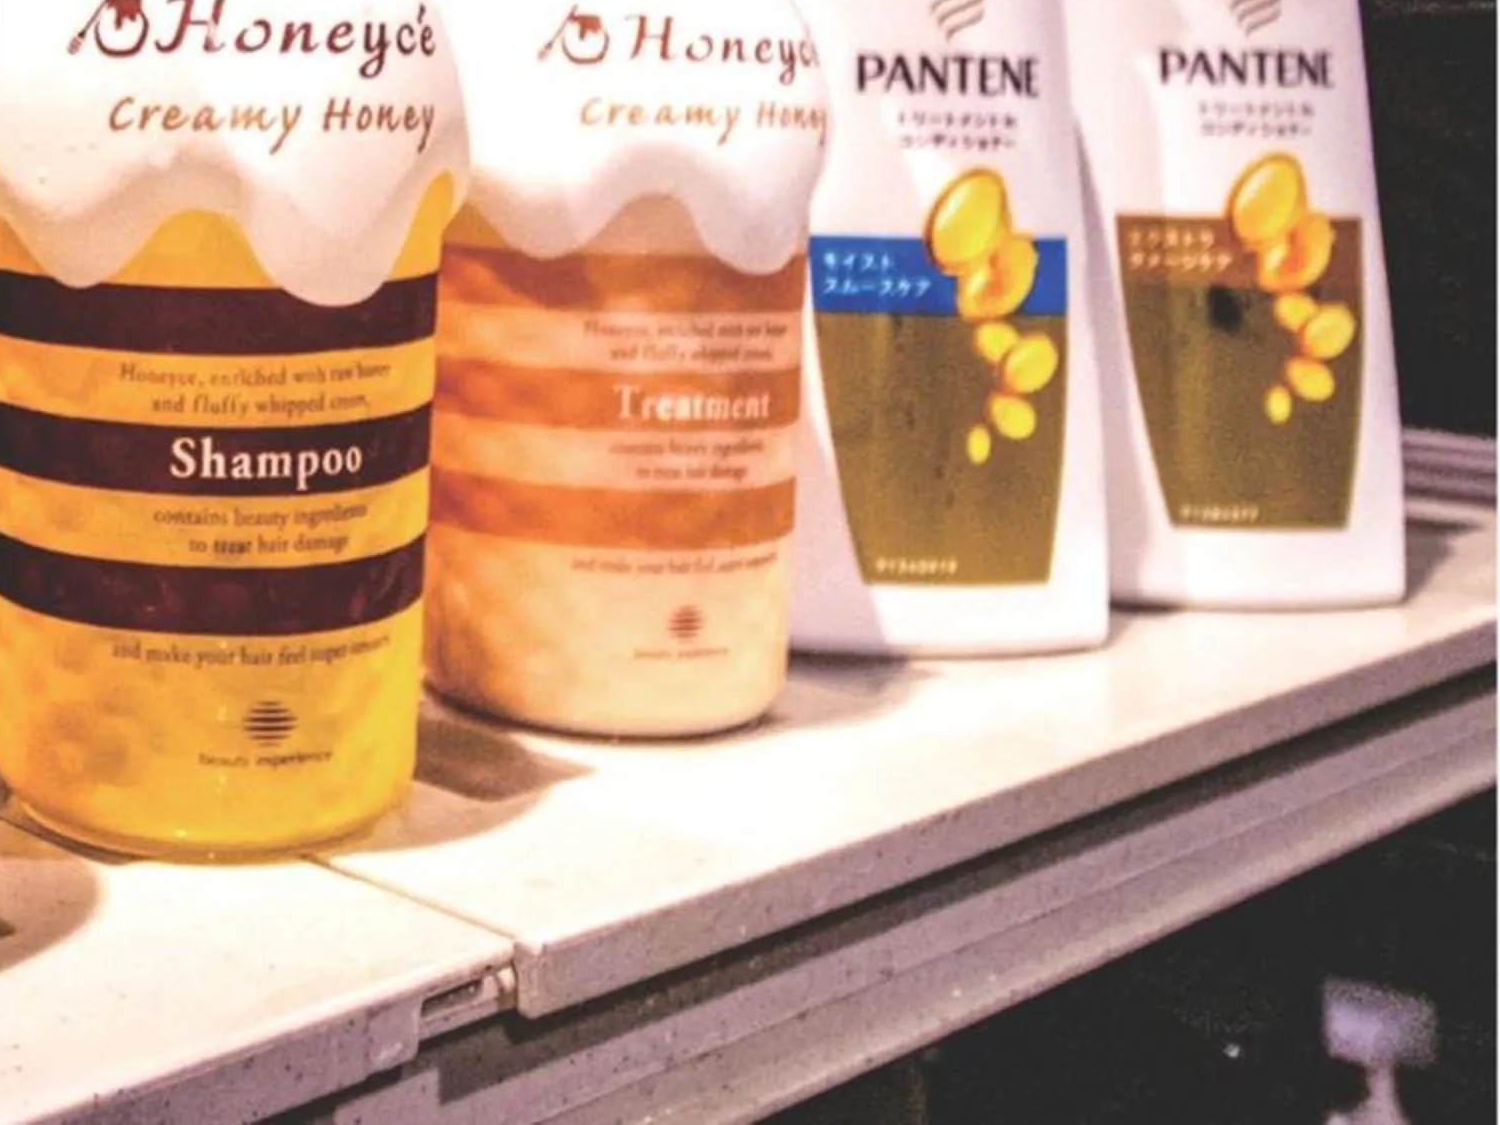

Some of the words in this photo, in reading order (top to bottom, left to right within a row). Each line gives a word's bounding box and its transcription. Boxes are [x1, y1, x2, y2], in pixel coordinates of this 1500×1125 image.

[856, 53, 1041, 98] PANTENE
[1159, 48, 1335, 89] PANTENE
[108, 96, 303, 156] Creamy
[322, 97, 436, 154] Honey
[580, 96, 741, 147] Creamy
[210, 363, 288, 387] enriched
[152, 395, 184, 414] and
[193, 393, 250, 417] fluffy
[255, 392, 328, 417] whipped
[613, 383, 771, 421] Treatment
[169, 436, 363, 491] Shampoo
[153, 506, 230, 526] contains
[189, 538, 207, 554] to
[257, 535, 290, 554] hair
[111, 641, 142, 660] and
[145, 643, 192, 664] make
[196, 649, 237, 669] your
[240, 647, 273, 666] hair
[278, 644, 308, 667] feel
